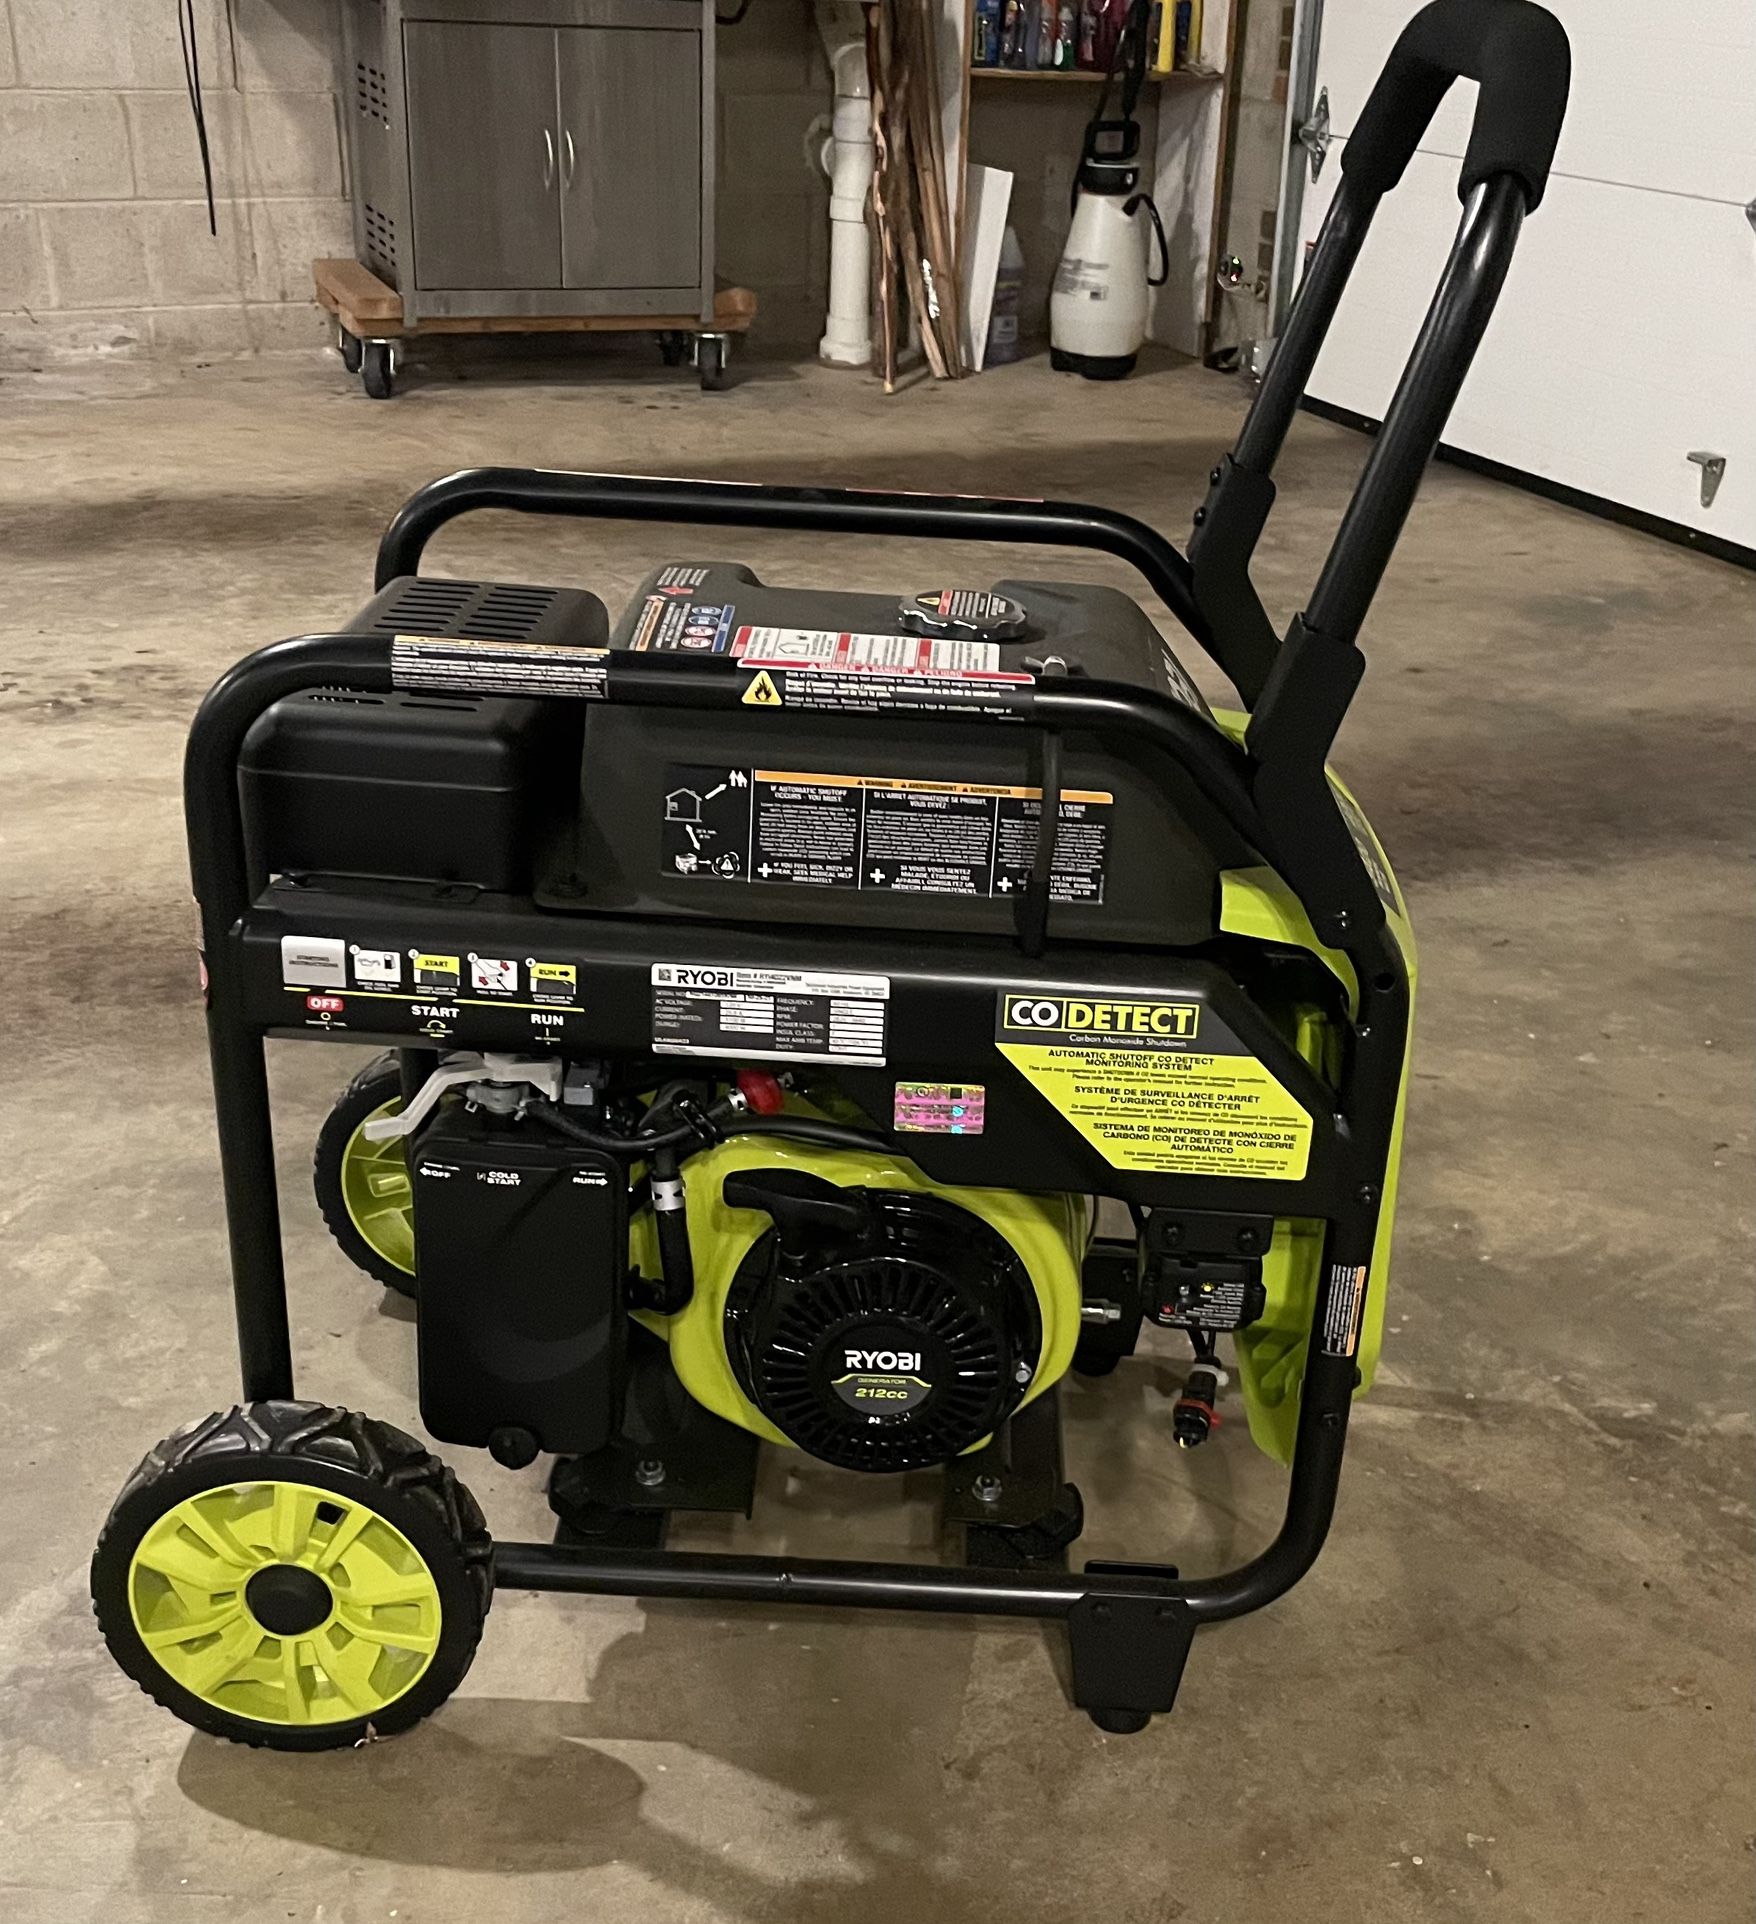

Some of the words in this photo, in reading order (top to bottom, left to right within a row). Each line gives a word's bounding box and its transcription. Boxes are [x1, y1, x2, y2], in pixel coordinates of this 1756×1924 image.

[425, 960, 448, 968] START
[538, 968, 556, 976] RUN
[676, 969, 734, 986] RYOBI
[310, 997, 340, 1009] OFF
[412, 1005, 460, 1018] START
[1011, 1000, 1060, 1026] CO
[1068, 1003, 1193, 1034] DETECT
[530, 1014, 564, 1026] RUN
[1069, 1034, 1100, 1043] Carbon
[1103, 1036, 1144, 1046] Monoxide
[1146, 1037, 1187, 1048] Shutdown
[1048, 1049, 1106, 1060] AUTOMATIC
[1109, 1052, 1155, 1064] SHUTOFF
[1158, 1055, 1173, 1064] CO
[1174, 1056, 1214, 1066] DETECT
[1085, 1058, 1149, 1070] MONITORING
[1152, 1062, 1192, 1072] SYSTEM
[1074, 1086, 1121, 1096] SYSTÈME
[1124, 1088, 1138, 1096] DE
[1140, 1089, 1215, 1100] SURVEILLANCE
[1217, 1092, 1260, 1104] D'ARRÊT
[1110, 1096, 1168, 1106] D'URGENCE
[1170, 1098, 1186, 1107] CO
[1188, 1100, 1241, 1110] DÉTECTER
[1093, 1122, 1136, 1132] SISTEMA
[1137, 1124, 1150, 1133] DE
[1152, 1126, 1210, 1136] MONITOREO
[1212, 1128, 1226, 1138] DE
[1228, 1128, 1281, 1141] MONÓXIDO
[1283, 1132, 1296, 1142] DE
[1103, 1130, 1150, 1142] CARBONO
[1152, 1133, 1172, 1143] (CO)
[1174, 1135, 1187, 1144] DE
[1190, 1136, 1234, 1146] DETECTE
[1236, 1138, 1258, 1148] CON
[1259, 1140, 1295, 1150] CIERRE
[1170, 1142, 1234, 1154] AUTOMÁTICO
[431, 1170, 451, 1178] OFF
[488, 1171, 519, 1180] COLD
[573, 1176, 596, 1184] RUN
[487, 1177, 521, 1186] START
[844, 1350, 921, 1371] RYOBI
[855, 1388, 908, 1399] 212cc
